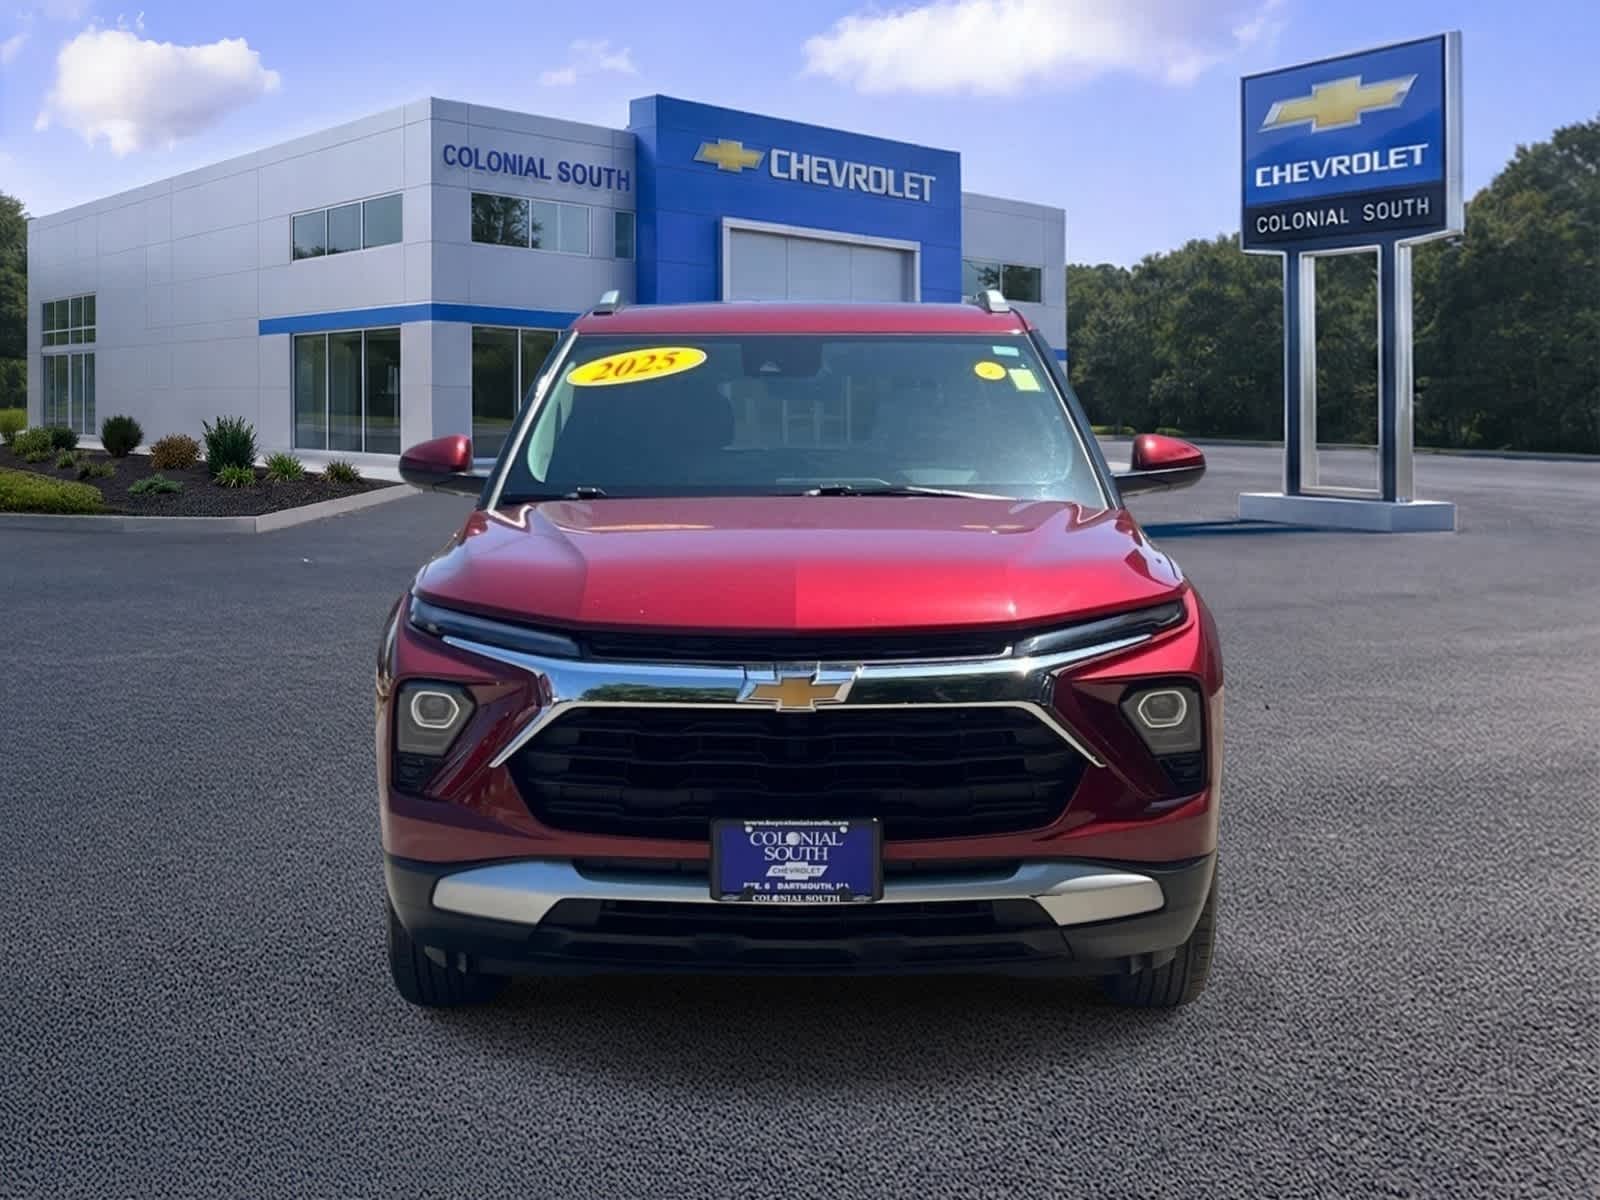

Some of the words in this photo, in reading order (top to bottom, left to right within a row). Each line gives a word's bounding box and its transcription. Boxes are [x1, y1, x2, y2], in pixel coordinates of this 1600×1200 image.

[443, 144, 552, 181] COLONIAL
[557, 161, 631, 192] SOUTH
[770, 147, 937, 203] CHEVROLET
[1255, 143, 1429, 188] CHEVROLET
[1256, 207, 1350, 234] COLONIAL
[1363, 197, 1430, 222] SOUTH
[591, 351, 681, 383] 2025
[750, 831, 843, 846] COLONIAL
[764, 847, 828, 861] SOUTH
[752, 894, 803, 903] COLONIAL
[805, 894, 841, 903] SOUTH
